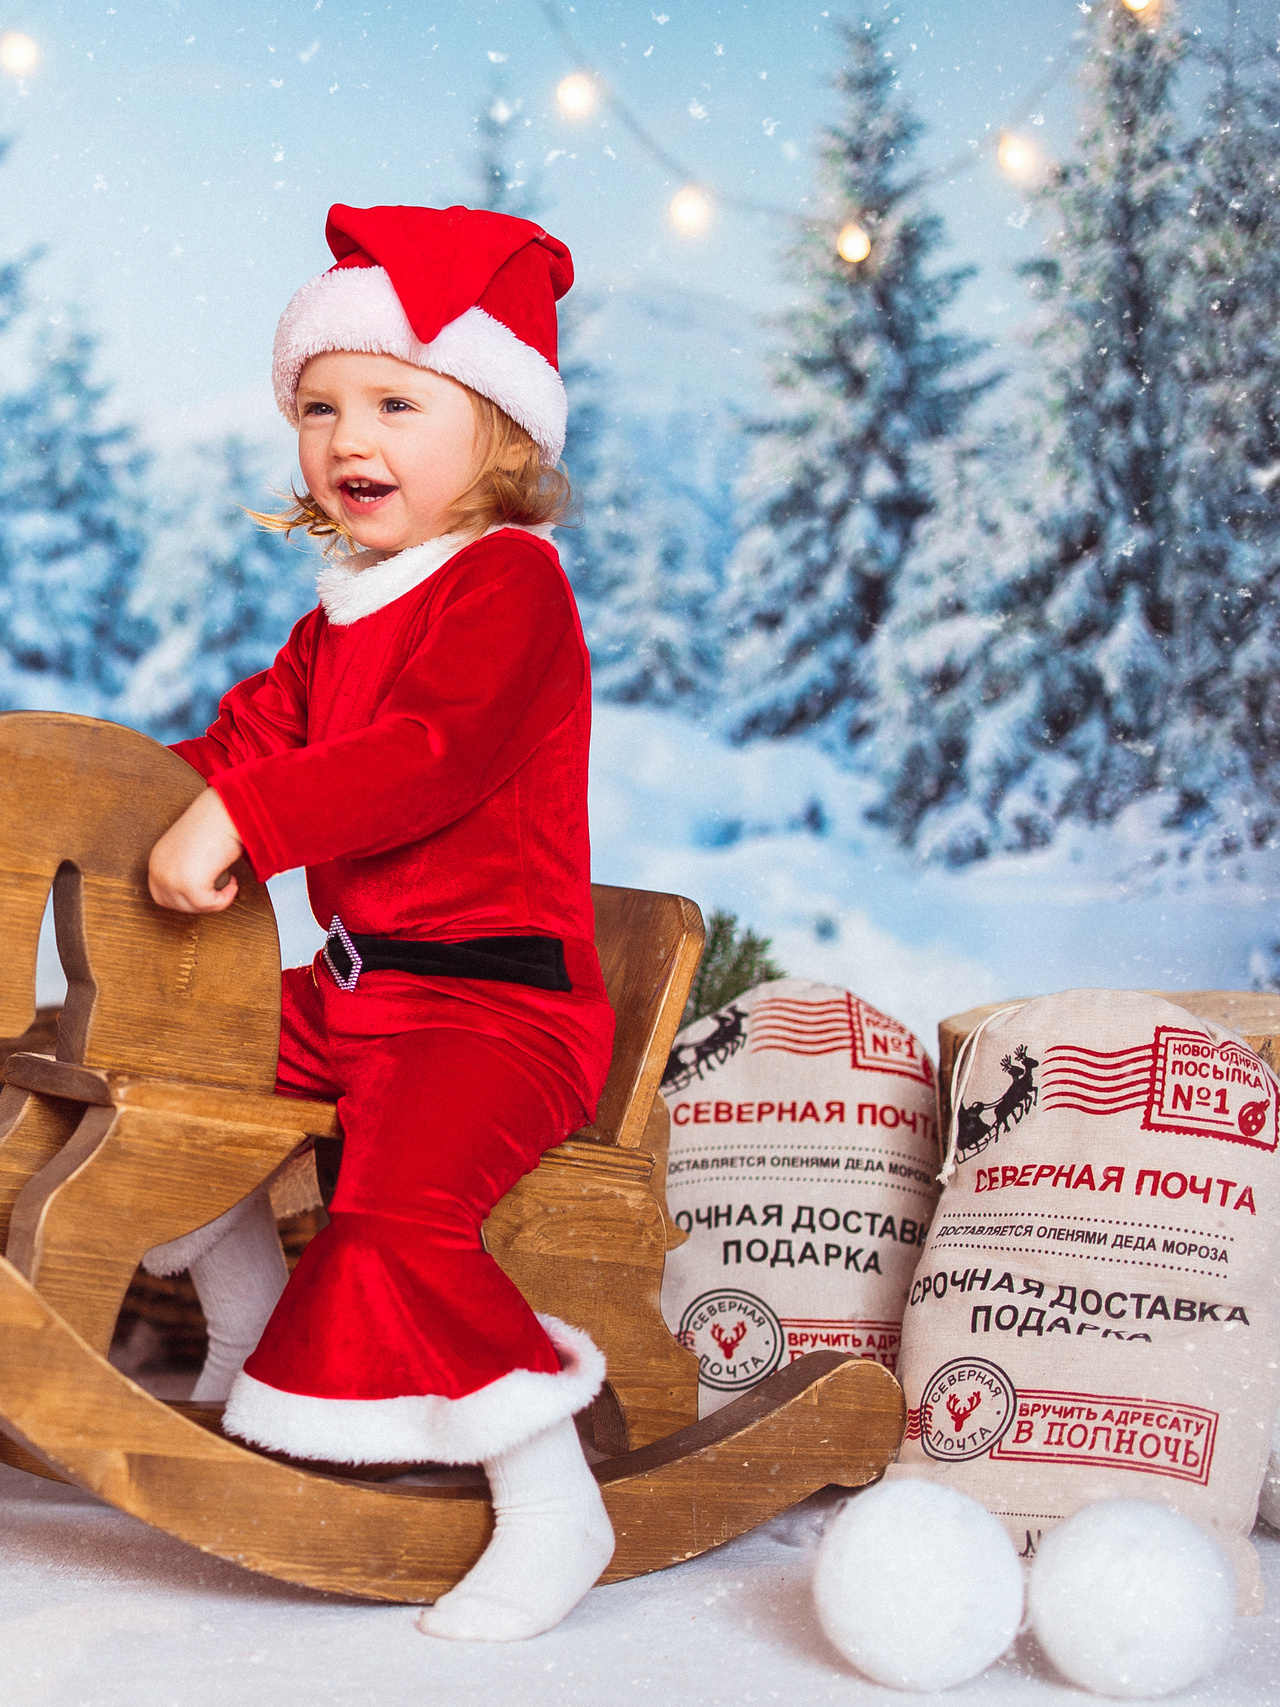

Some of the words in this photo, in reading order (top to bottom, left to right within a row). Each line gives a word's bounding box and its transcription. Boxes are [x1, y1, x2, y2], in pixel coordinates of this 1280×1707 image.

[1171, 1060, 1265, 1091] ПОСЫЛКА
[673, 1101, 845, 1126] СЕВЕРНАЯ
[668, 1155, 766, 1175] ОСТАВЛЯЕТСЯ
[770, 1155, 840, 1169] ОЛЕНЯМИ
[845, 1157, 885, 1172] ДЕДА
[974, 1164, 1125, 1193] СЕВЕРНАЯ
[1135, 1169, 1257, 1216] ПОЧТА
[675, 1203, 783, 1234] ОЧНАЯ
[722, 1238, 883, 1275] ПОДАРКА
[936, 1225, 1033, 1239] ДОСТАВЛЯЕТСЯ
[1036, 1226, 1108, 1246] ОЛЕНЯМИ
[1111, 1234, 1157, 1251] ДЕДА
[1162, 1239, 1229, 1264] МОРОЗА
[910, 1268, 1045, 1307] СРОЧНАЯ
[1048, 1284, 1250, 1326] ДОСТАВКА
[692, 1301, 766, 1332] СЕВЕРНАЯ
[971, 1304, 1152, 1343] ПОДАРКА
[788, 1332, 862, 1348] ВРУЧИТЬ
[699, 1354, 764, 1378] ПОЧТА
[931, 1369, 1002, 1403] СЕВЕРНАЯ
[1018, 1402, 1098, 1421] ВРУЧИТЬ
[1101, 1409, 1205, 1437] АДРЕСАТУ
[931, 1427, 992, 1451] ПОЧТА
[1012, 1420, 1034, 1444] В
[1043, 1421, 1200, 1468] ПОЛНОЧЬ
